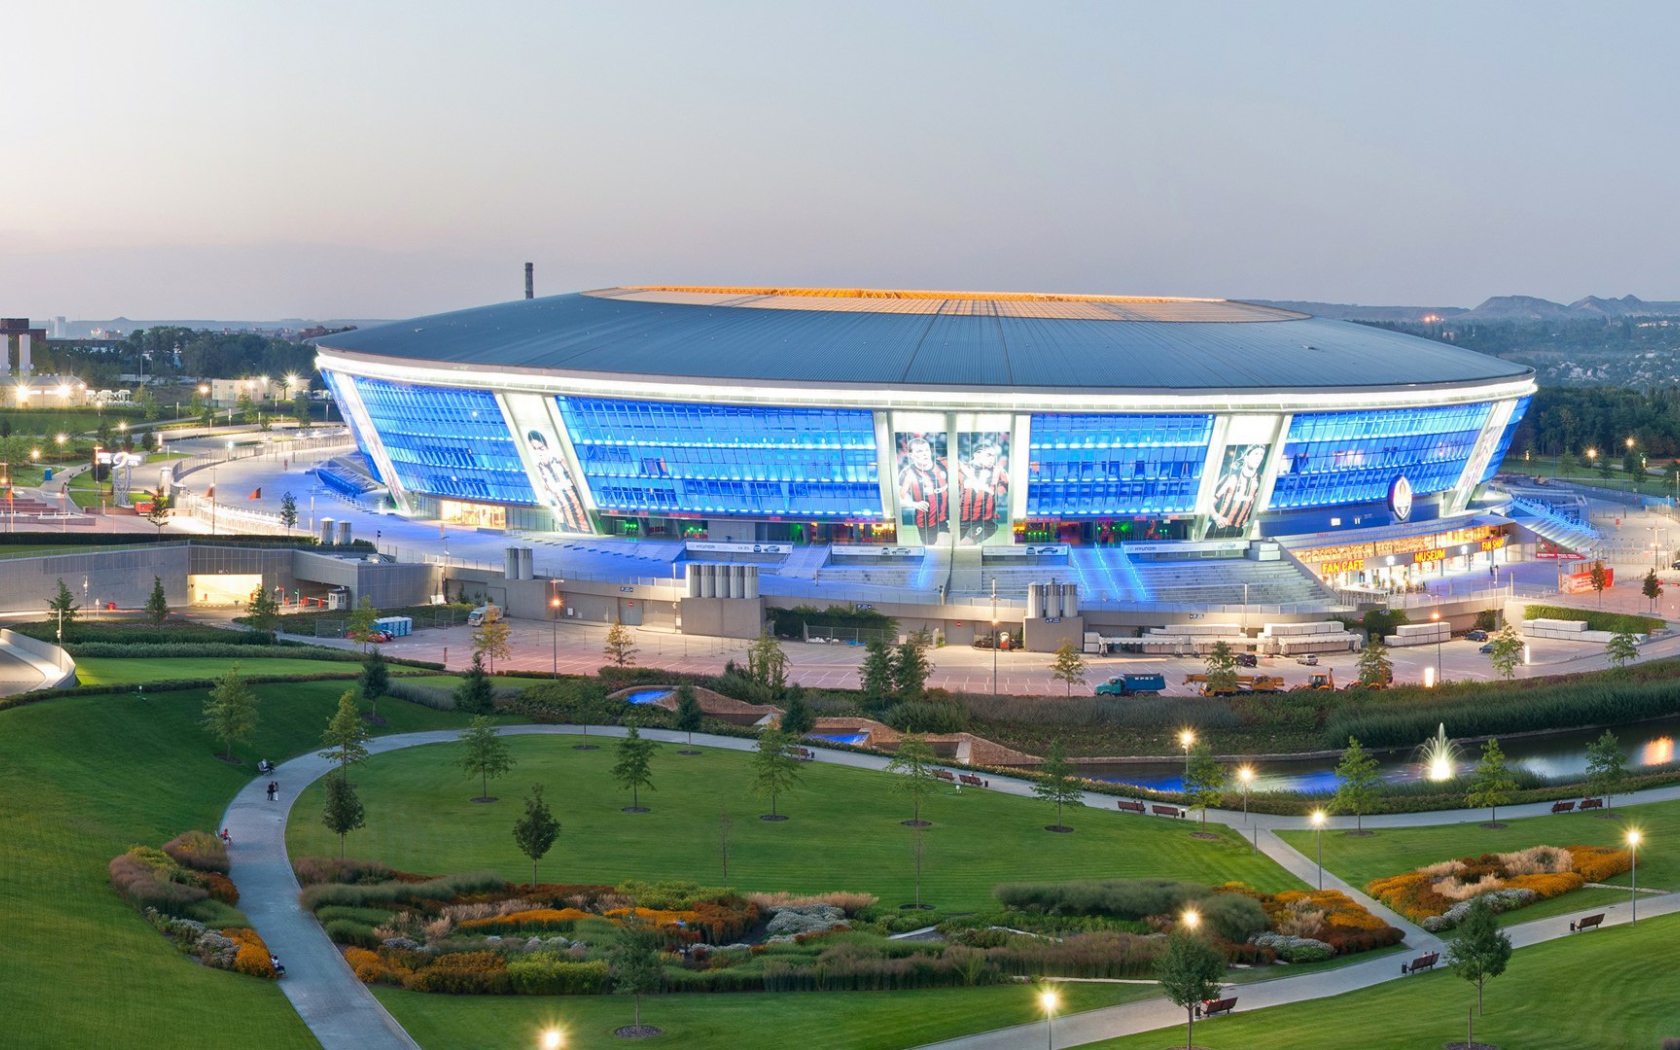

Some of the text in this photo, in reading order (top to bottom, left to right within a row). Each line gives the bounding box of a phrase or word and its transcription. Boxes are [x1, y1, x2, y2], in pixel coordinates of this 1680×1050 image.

[975, 526, 982, 535] 9
[1481, 540, 1491, 552] FAN
[1414, 549, 1446, 563] MUSEUM
[1321, 559, 1364, 575] FAN CAFE
